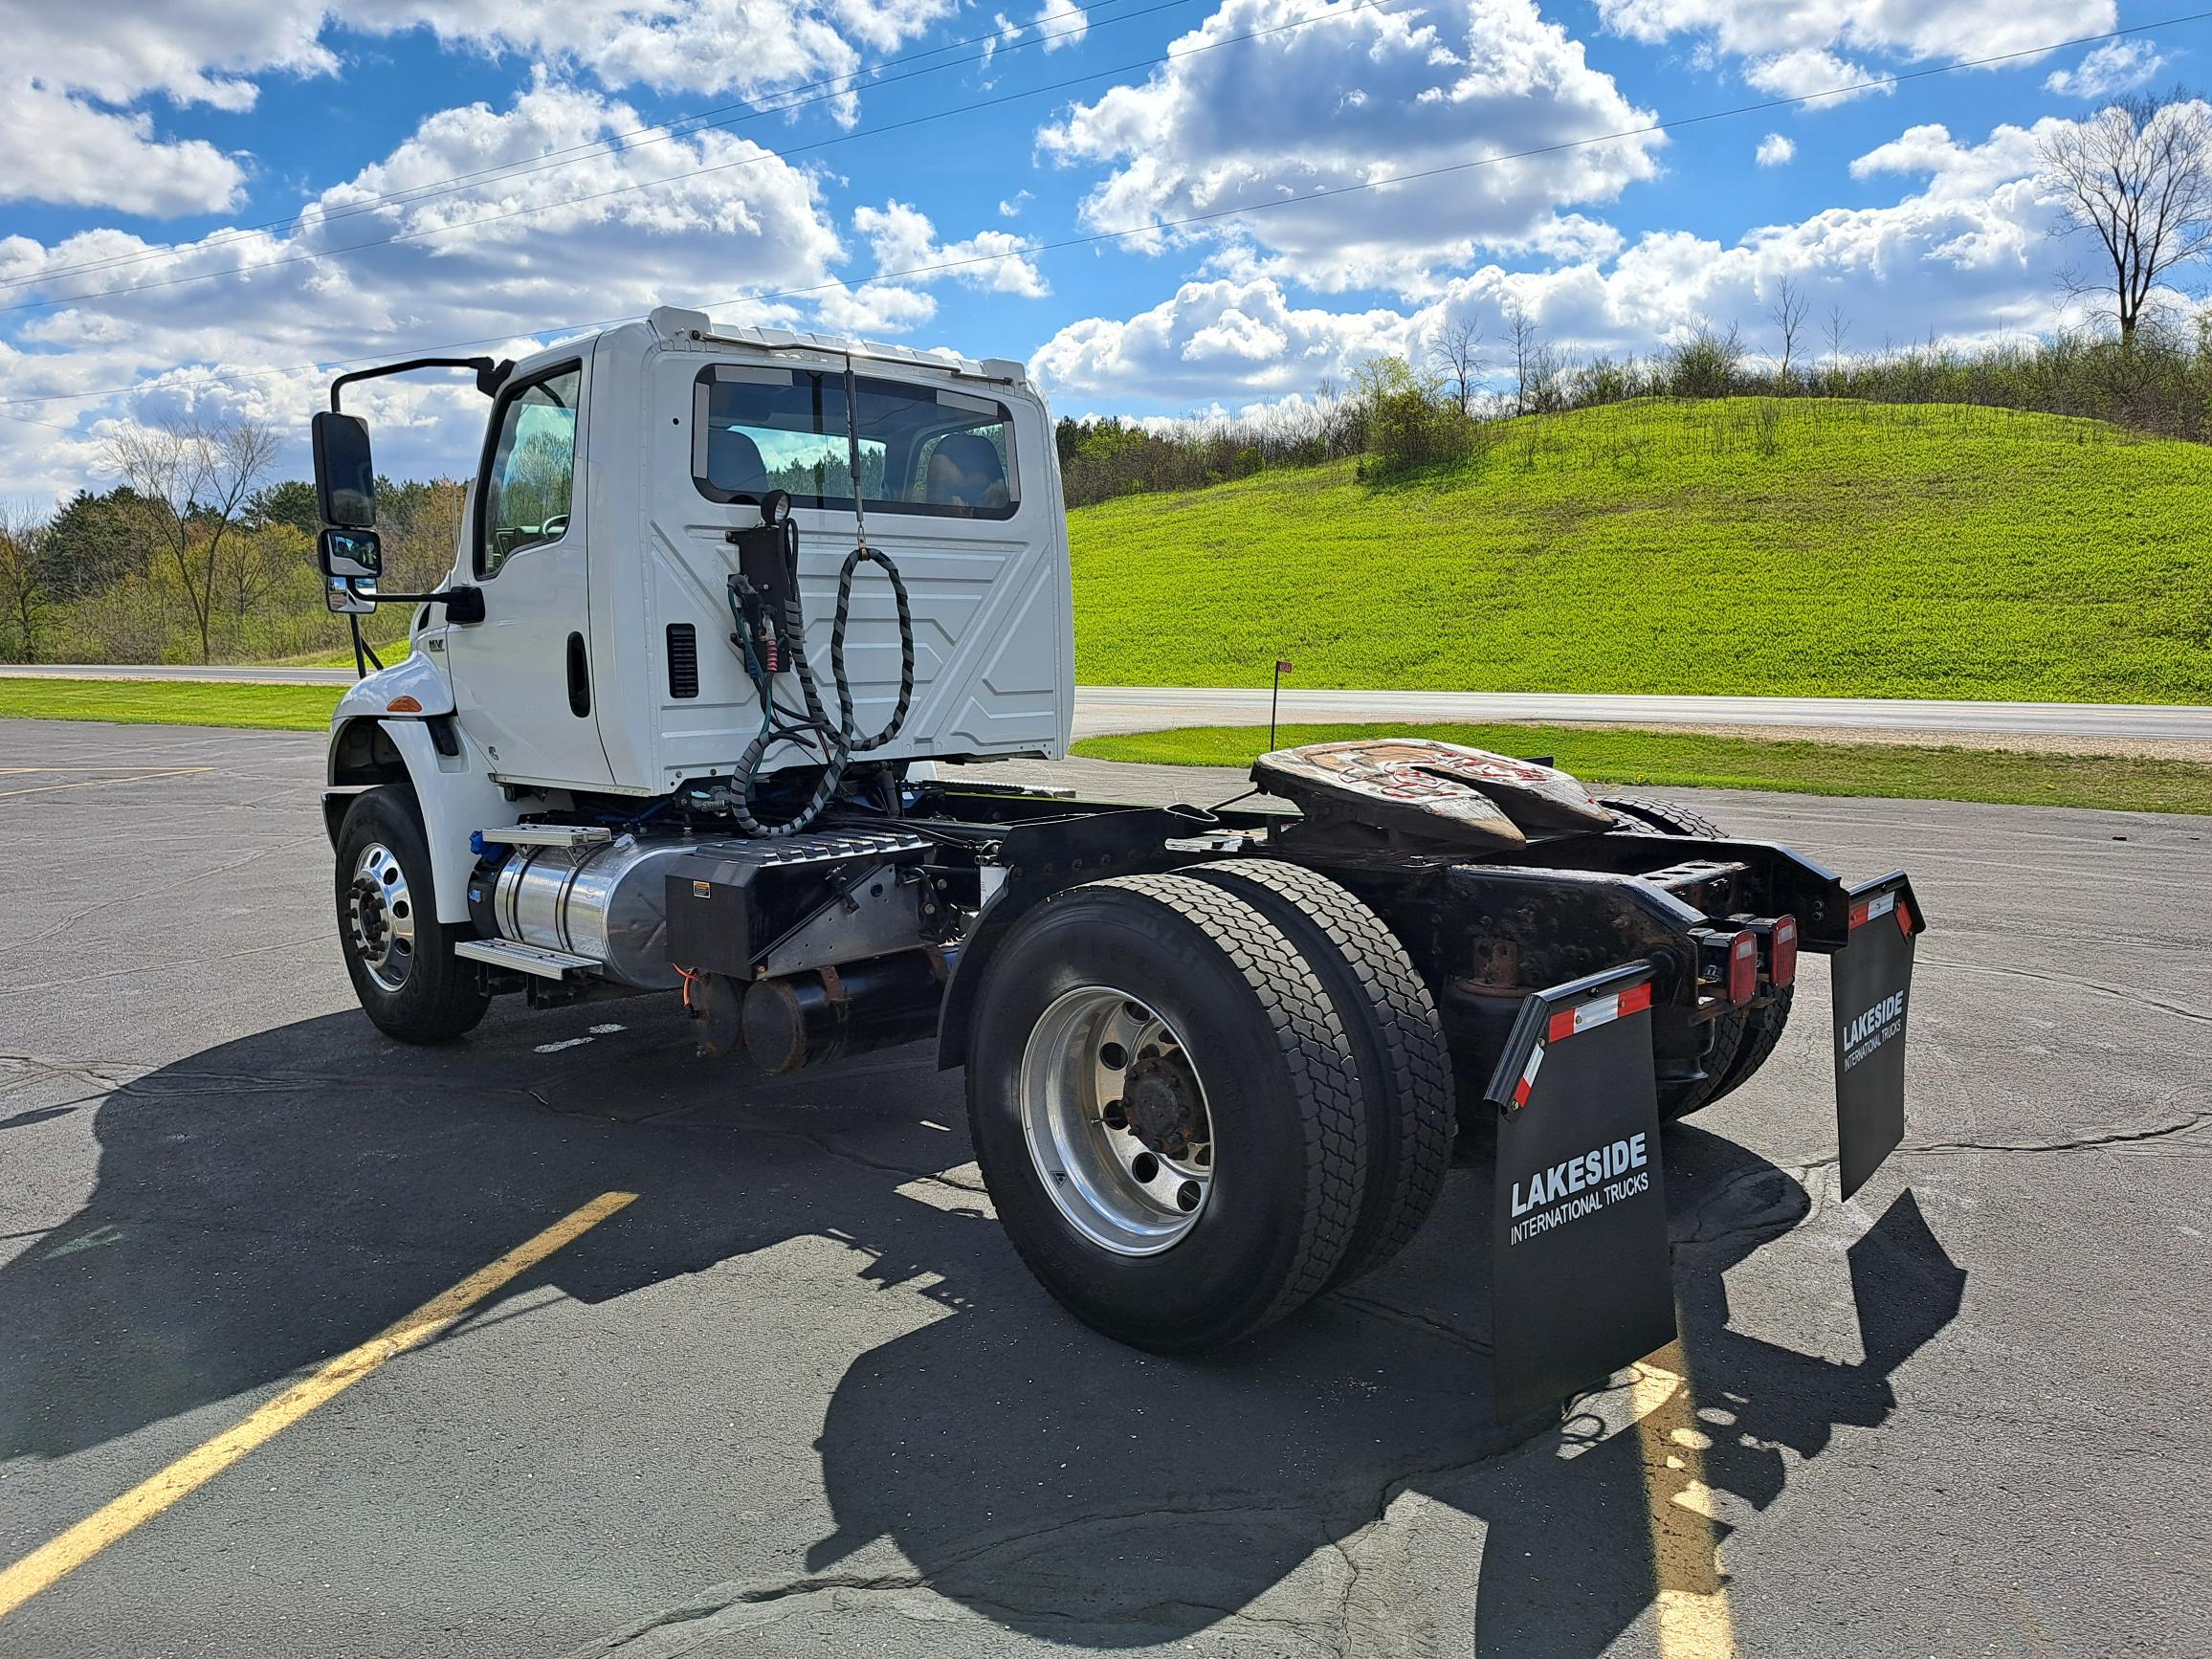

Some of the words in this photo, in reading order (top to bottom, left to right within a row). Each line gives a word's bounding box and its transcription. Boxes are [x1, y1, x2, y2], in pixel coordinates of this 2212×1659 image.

[1843, 989, 1904, 1052] LAKESIDE
[1844, 1033, 1882, 1073] INTERNATIONAL
[1881, 1018, 1902, 1043] TRUCKS
[1510, 1191, 1604, 1246] INTERNATIONAL
[1603, 1171, 1649, 1206] TRUCKS
[1511, 1132, 1648, 1218] LAKESIDE
